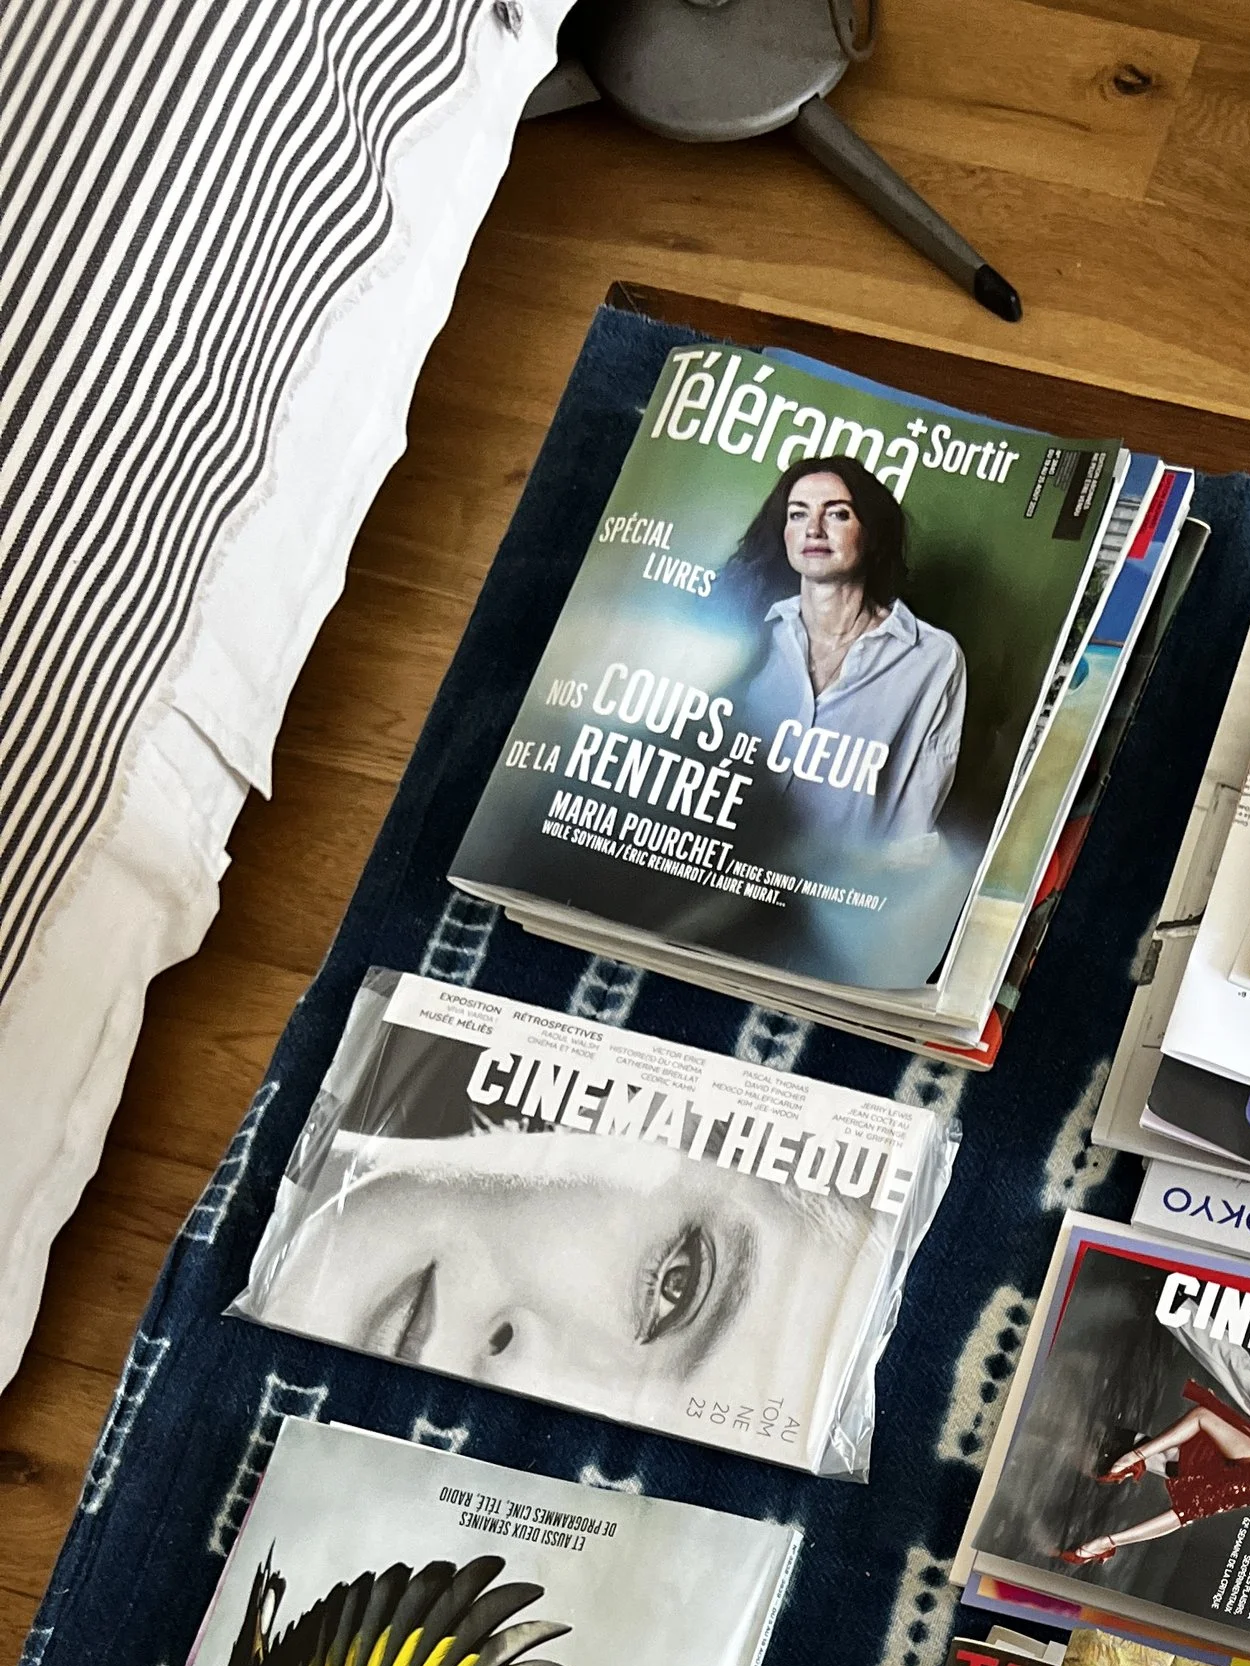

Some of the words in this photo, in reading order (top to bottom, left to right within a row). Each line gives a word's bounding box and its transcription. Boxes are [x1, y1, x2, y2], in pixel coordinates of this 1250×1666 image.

[599, 512, 673, 550] SPÉCIAL
[643, 553, 716, 598] LIVRES
[546, 679, 588, 709] NOS
[592, 663, 733, 752] COUPS
[729, 732, 762, 765] DE
[506, 740, 530, 768] DE
[533, 743, 561, 773] LA
[565, 724, 753, 830] RENTRÉE
[542, 820, 570, 842] WOLE
[571, 828, 616, 858] SOYINKA
[622, 845, 648, 867] ÉRIC
[648, 854, 704, 884] REINHARDT
[710, 874, 744, 896] LAURE
[548, 790, 618, 836] MARIA
[619, 812, 733, 870] POURCHET
[801, 878, 845, 904] MATHIAS
[419, 1007, 454, 1025] MUSÉE
[456, 1017, 494, 1035] MÉLIÈS
[439, 991, 502, 1015] EXPOSITION
[512, 1009, 604, 1041] RÉTROSPECTIVES
[467, 1048, 915, 1216] CINEMATHEQUE
[686, 1397, 706, 1419] 23
[710, 1402, 729, 1425] 20
[733, 1405, 754, 1432] NE
[756, 1398, 784, 1438] TOM
[439, 1486, 473, 1507] RADIO
[459, 1511, 511, 1536] SEMAINES
[512, 1525, 541, 1542] DEUX
[533, 1508, 603, 1535] PROGRAMMES
[601, 1522, 617, 1537] DE
[541, 1530, 571, 1549] AUSSI
[571, 1536, 586, 1551] ET
